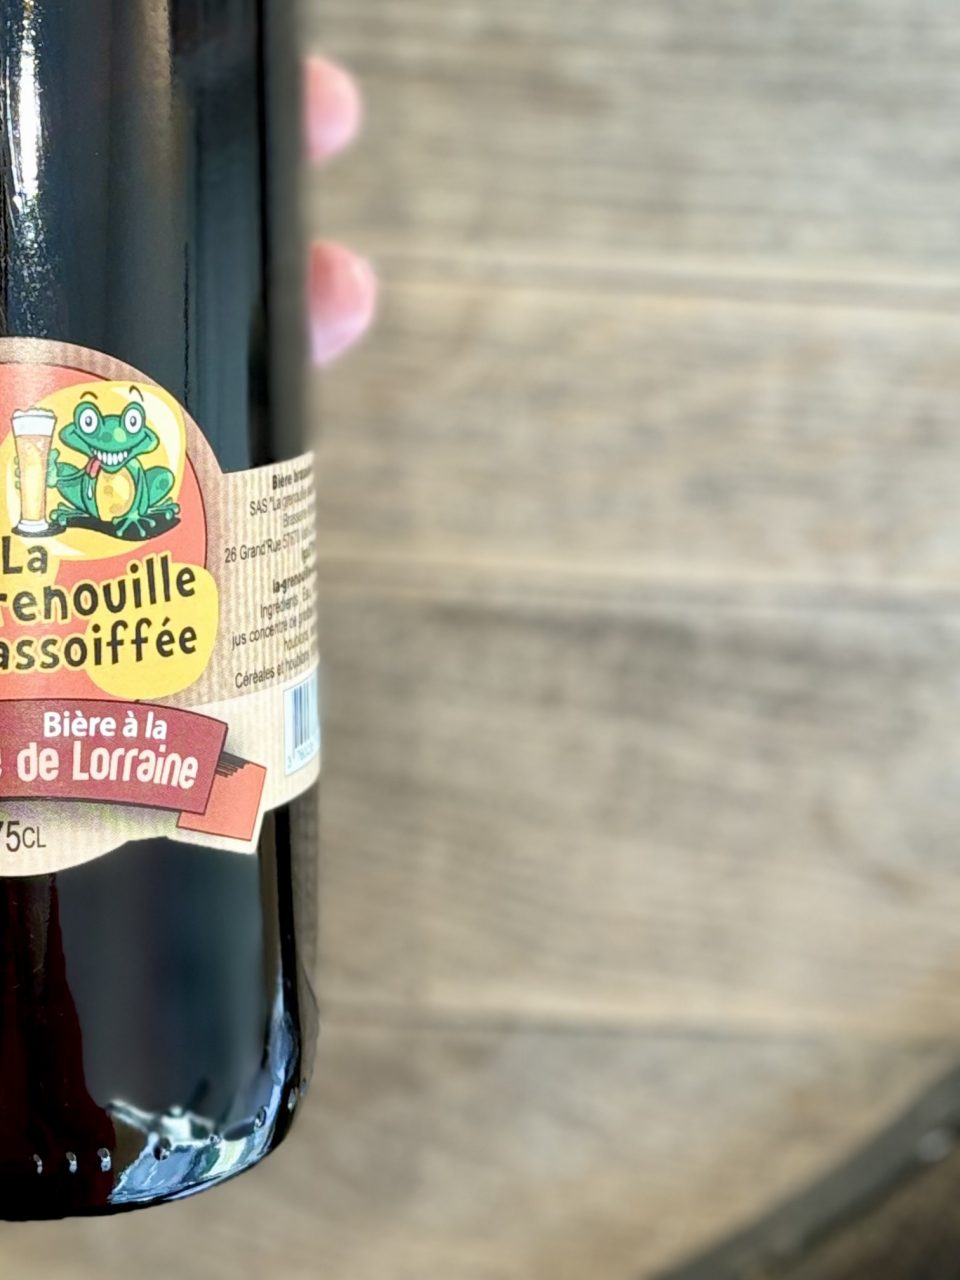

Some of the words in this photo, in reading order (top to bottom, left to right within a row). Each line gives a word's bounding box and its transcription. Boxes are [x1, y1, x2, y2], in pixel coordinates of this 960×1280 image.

[249, 498, 268, 516] SAS
[1, 535, 49, 575] La
[224, 547, 237, 564] 26
[232, 631, 247, 651] jus
[234, 664, 275, 689] Céréales
[43, 710, 117, 739] Bière
[122, 710, 138, 738] à
[144, 711, 168, 740] la
[16, 741, 60, 783] de
[71, 740, 199, 790] Lorraine
